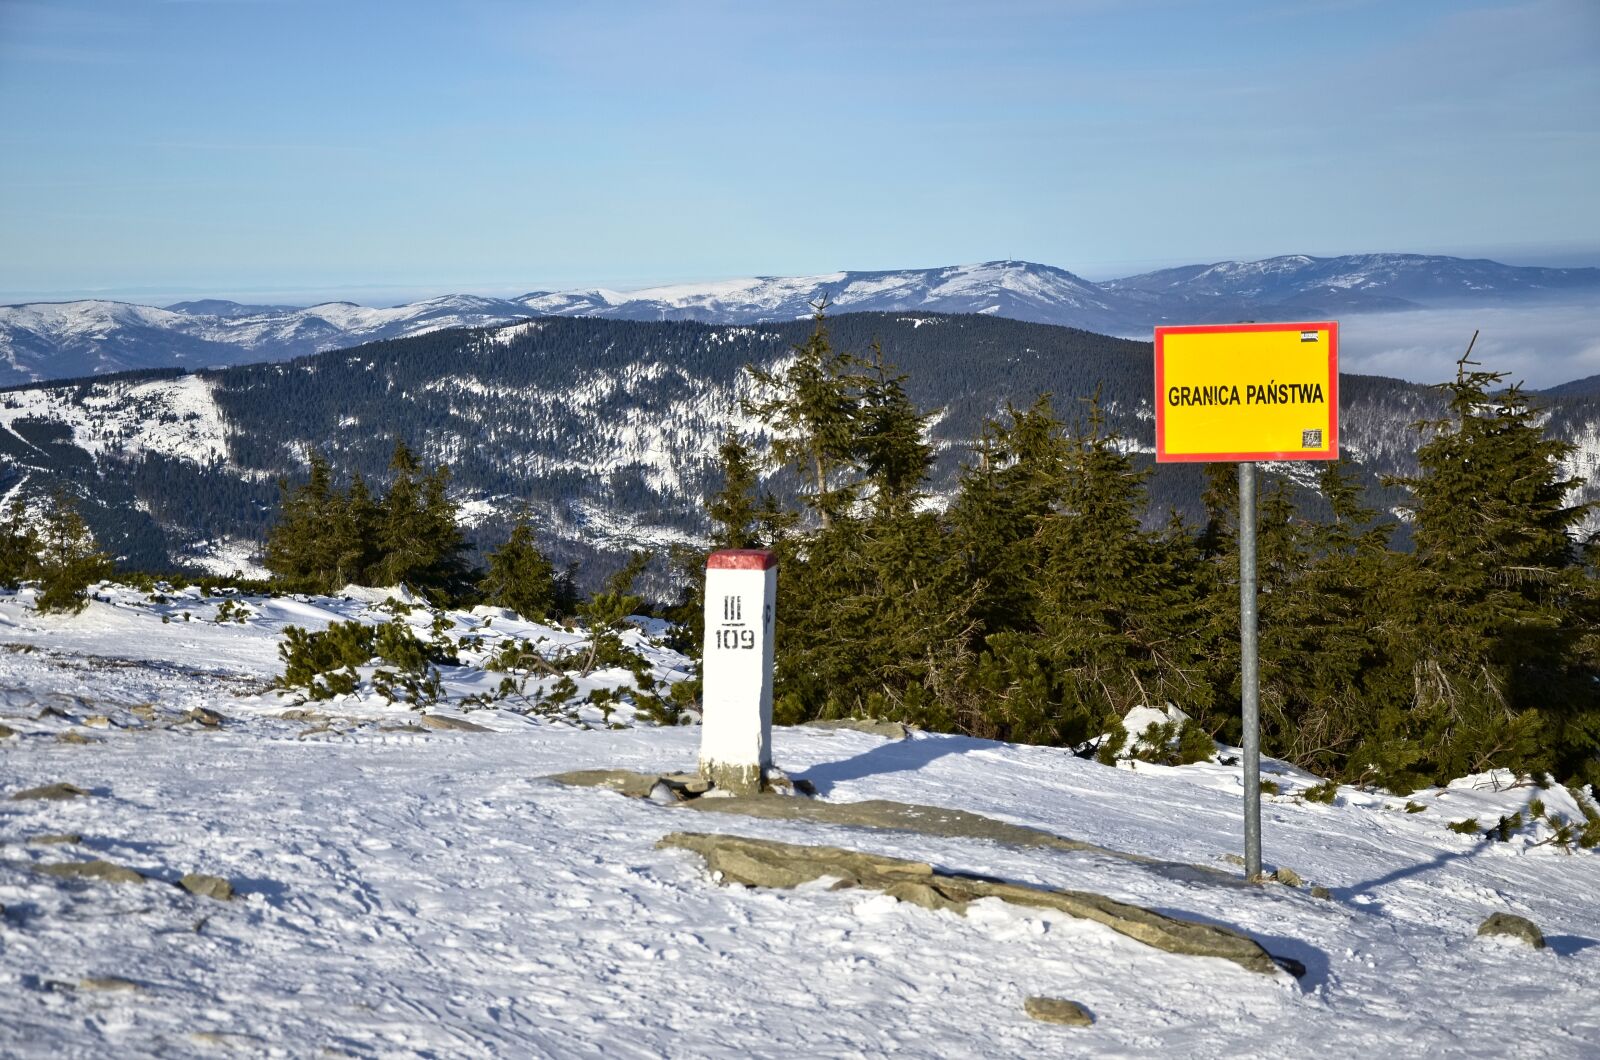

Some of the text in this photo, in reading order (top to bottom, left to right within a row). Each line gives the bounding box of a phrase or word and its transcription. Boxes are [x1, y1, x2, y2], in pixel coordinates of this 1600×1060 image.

[1168, 380, 1324, 407] GRANICA PAŃSTWA
[716, 629, 754, 650] 109
